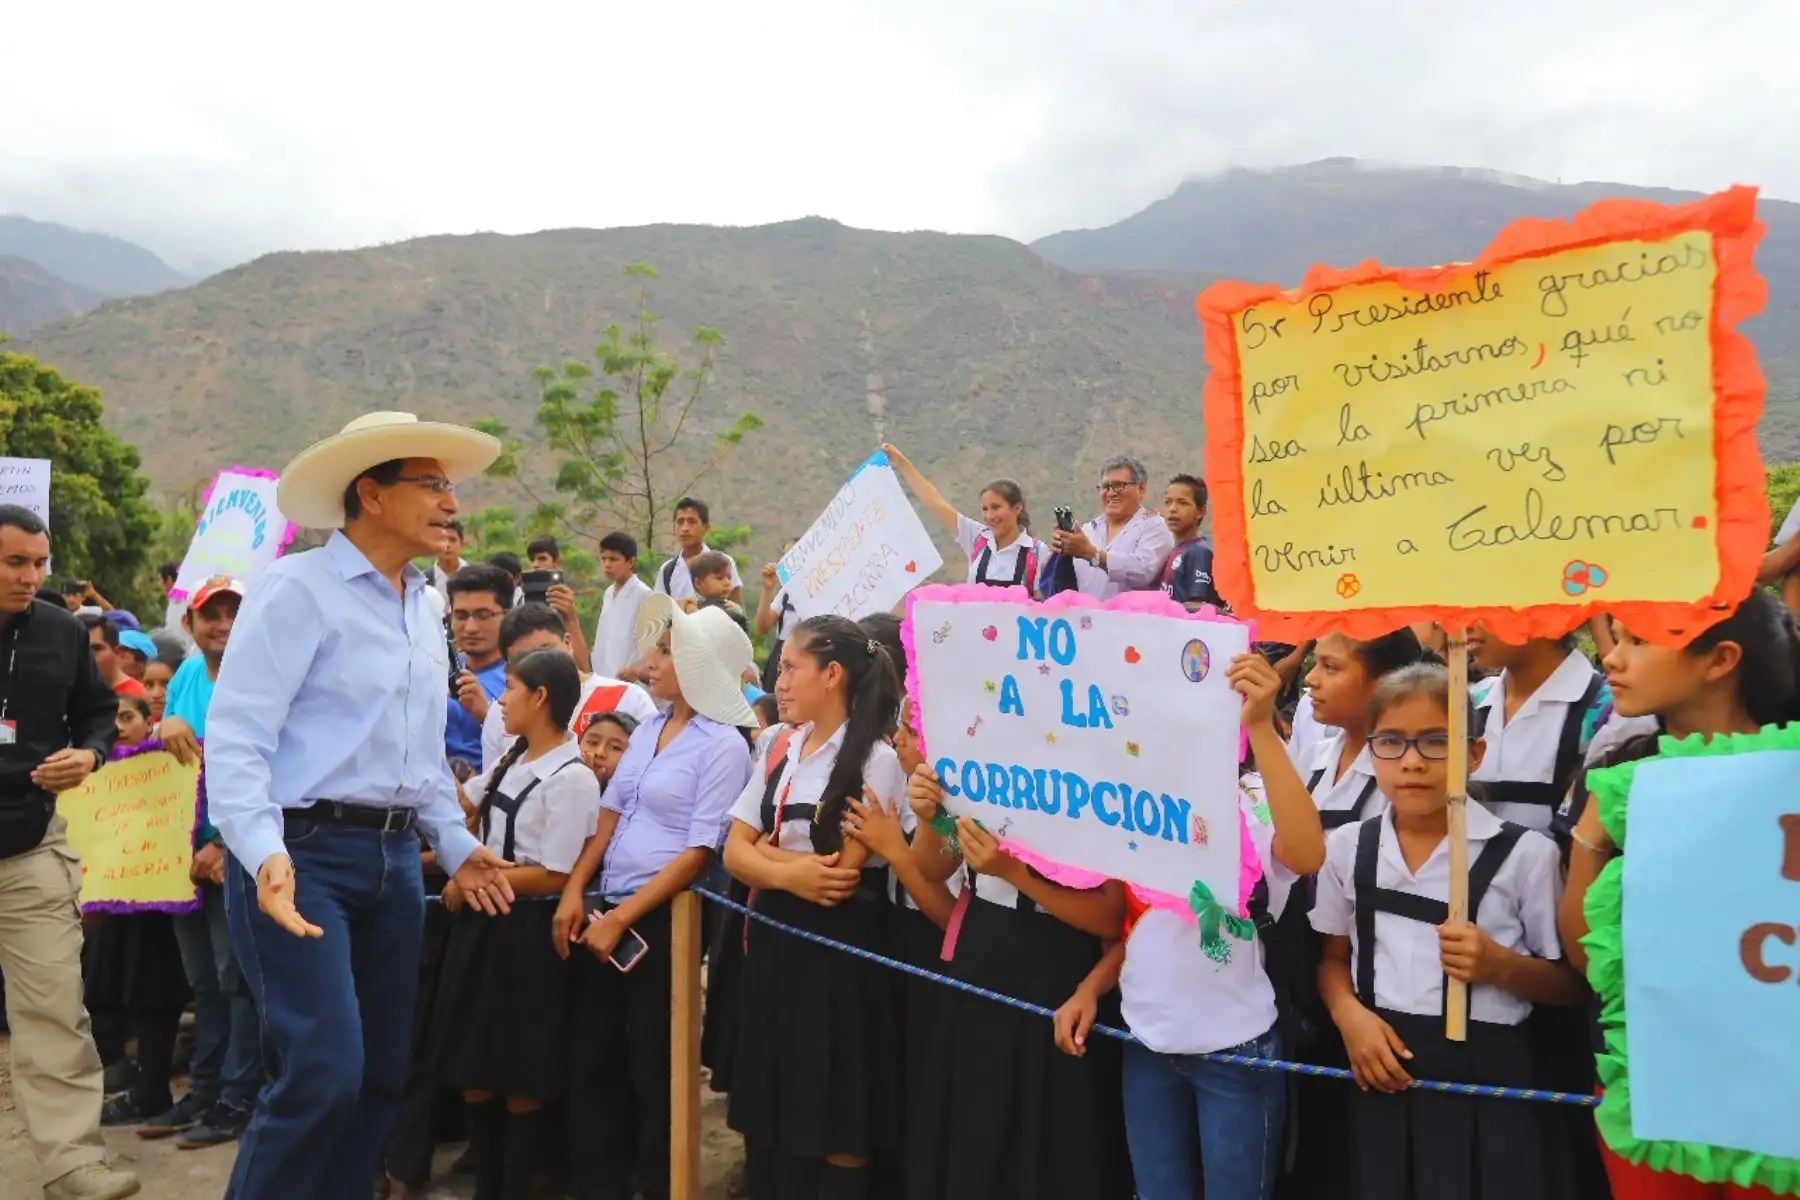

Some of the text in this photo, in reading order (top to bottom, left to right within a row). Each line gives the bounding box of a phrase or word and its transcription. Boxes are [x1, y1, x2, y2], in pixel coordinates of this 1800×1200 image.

[1242, 243, 1707, 349] Sr Presidente gracias
[1248, 373, 1300, 415] por
[1560, 306, 1636, 369] qué
[1654, 310, 1704, 335] no
[1248, 358, 1669, 464] sea la primera ni
[1251, 418, 1686, 519] la última vez por
[1255, 542, 1356, 573] venir
[1397, 539, 1419, 555] a
[1016, 615, 1077, 666] NO
[998, 674, 1114, 729] A LA
[934, 757, 1192, 844] CORRUPCION
